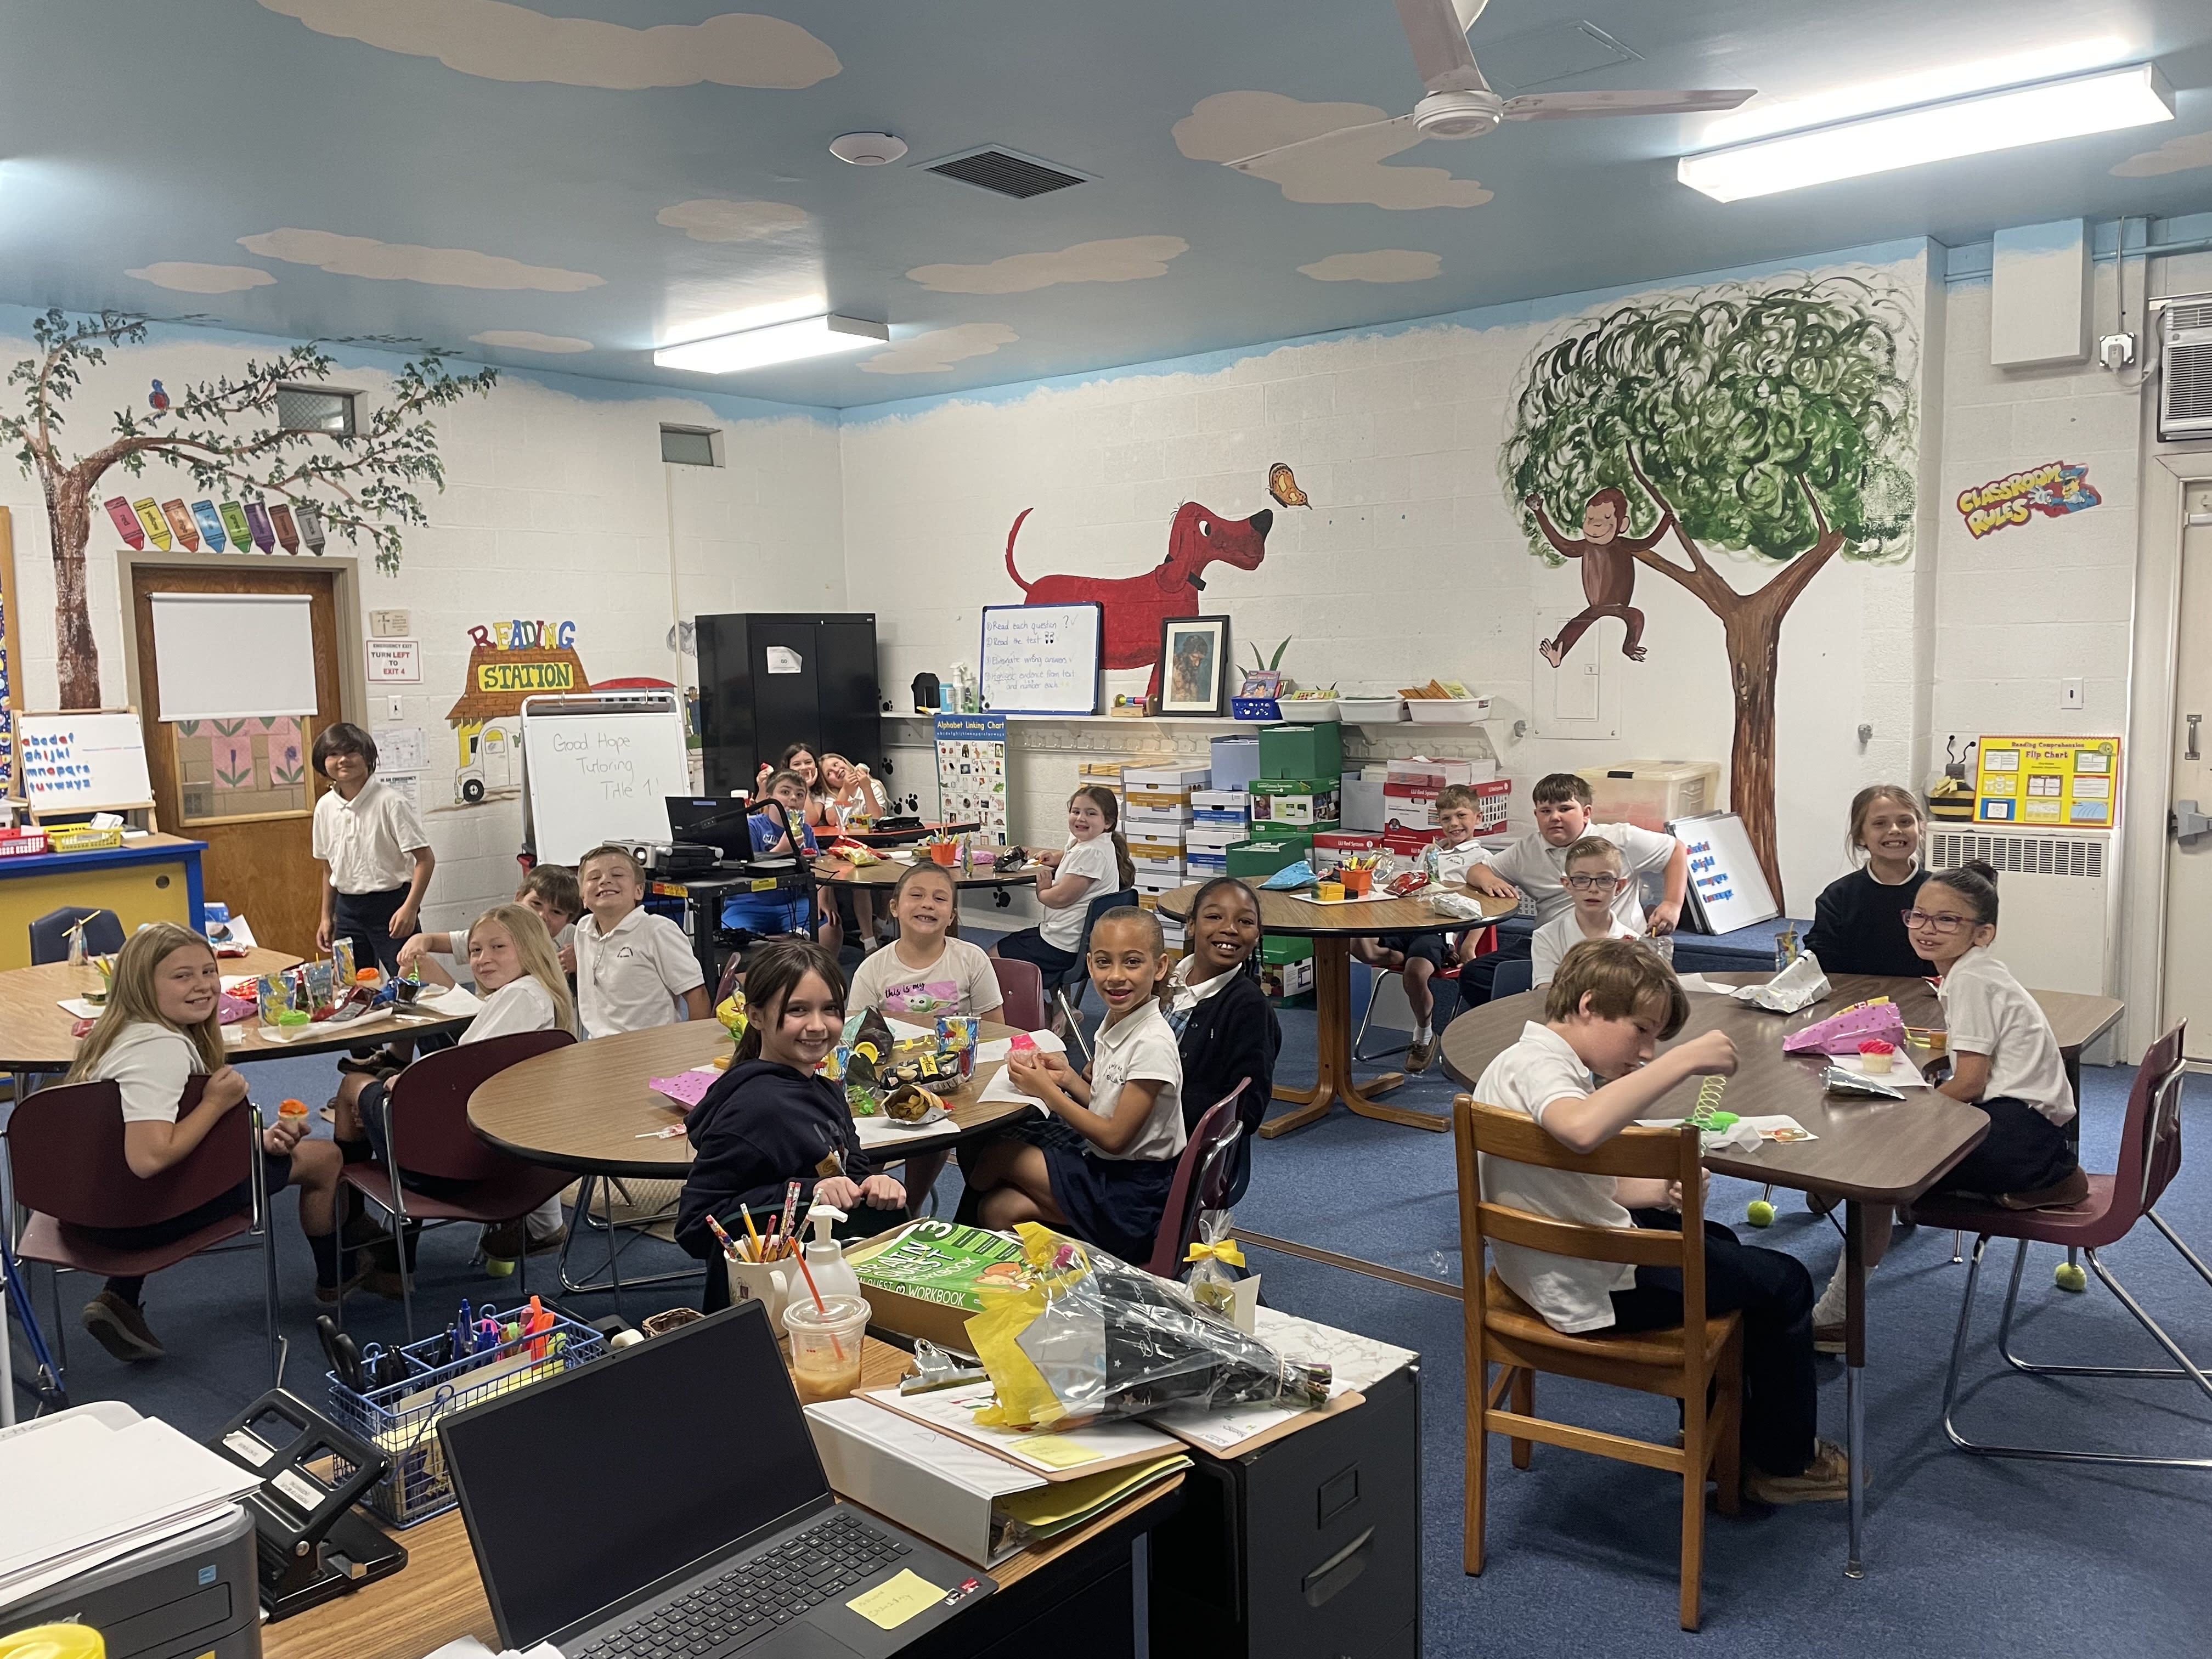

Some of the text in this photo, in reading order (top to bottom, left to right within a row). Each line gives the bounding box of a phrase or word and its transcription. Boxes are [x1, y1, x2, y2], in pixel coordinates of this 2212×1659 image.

[1960, 464, 2063, 512] CLASSROOM
[120, 515, 129, 526] red
[144, 510, 159, 531] yellow
[305, 517, 315, 535] black
[1967, 498, 2029, 536] RULES
[467, 619, 576, 654] READING
[992, 621, 1009, 630] Read
[1031, 622, 1057, 635] question
[993, 637, 1008, 646] Read
[484, 663, 570, 689] STATION
[937, 720, 1005, 731] Alphabet Linking Chart
[553, 732, 630, 755] Good Hope
[2025, 751, 2041, 759] Flip
[576, 757, 634, 783] Tutoring
[600, 781, 633, 800] Title
[885, 983, 926, 998] this is my
[918, 1220, 953, 1238] 3
[852, 1240, 933, 1273] BRAIN
[873, 1249, 955, 1278] QUEST
[908, 1284, 967, 1307] WORKBOOK
